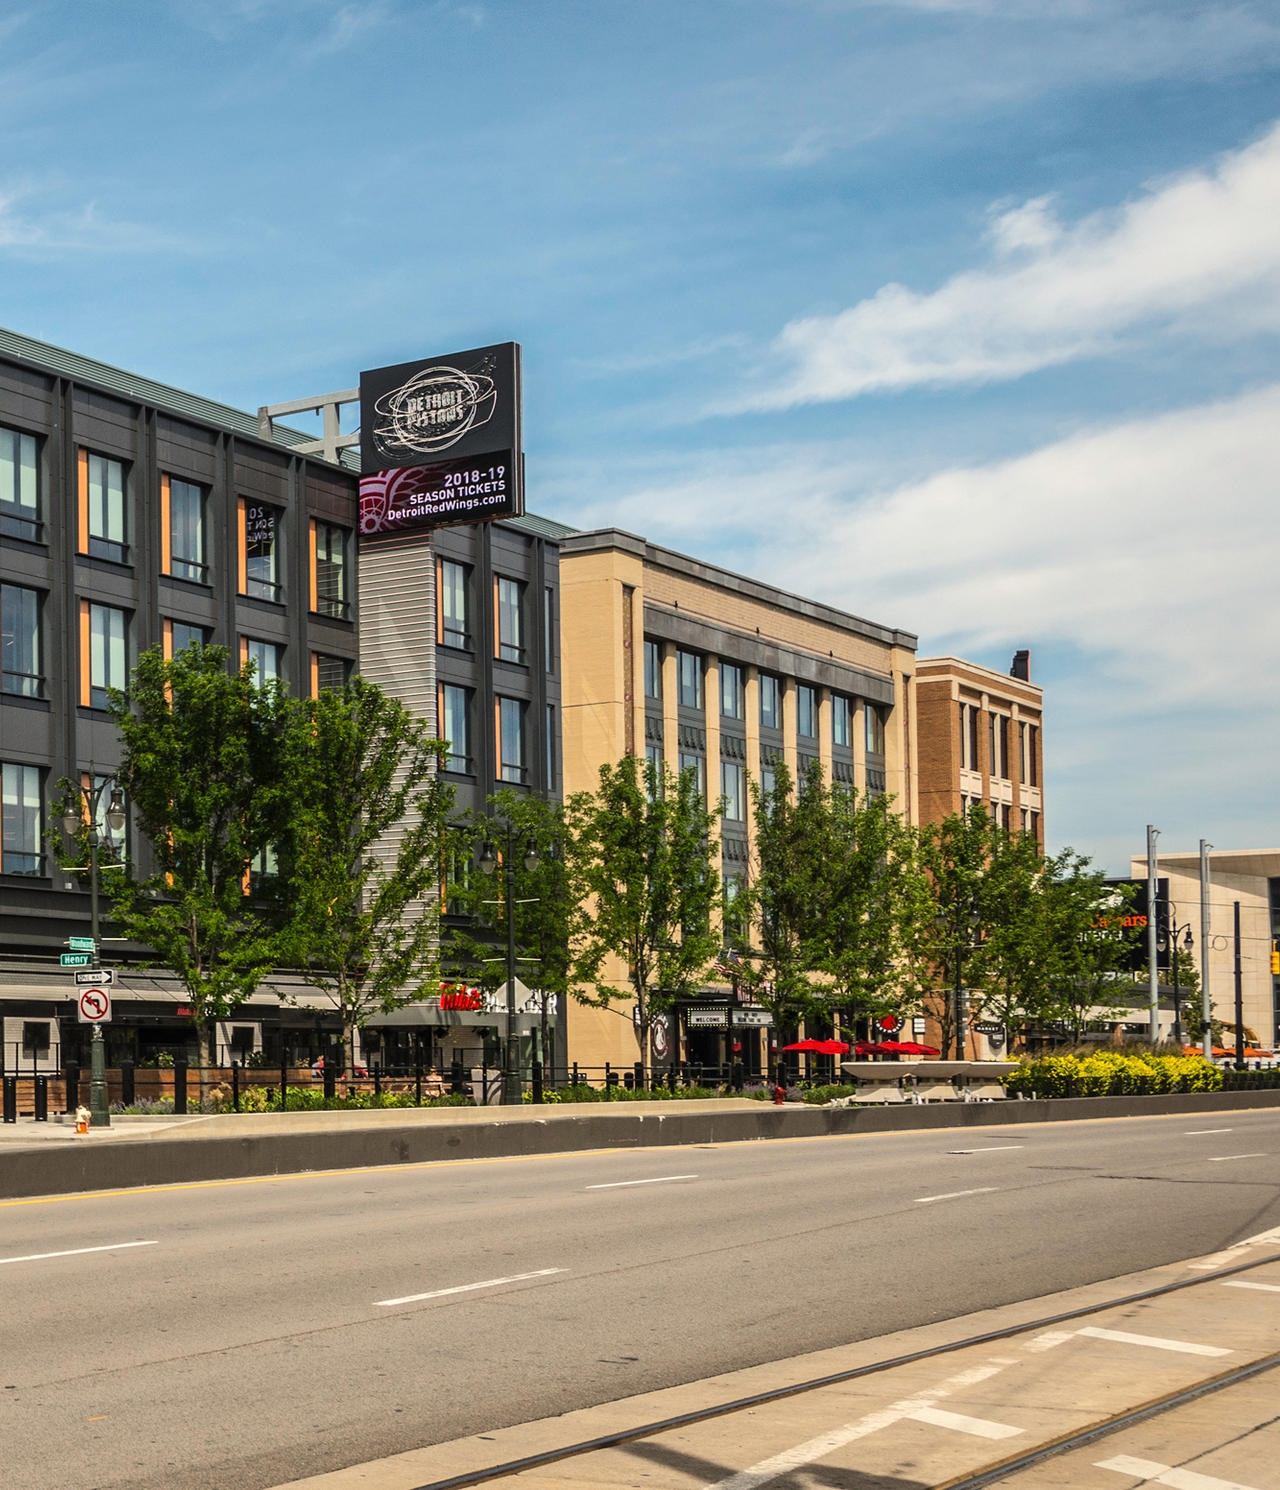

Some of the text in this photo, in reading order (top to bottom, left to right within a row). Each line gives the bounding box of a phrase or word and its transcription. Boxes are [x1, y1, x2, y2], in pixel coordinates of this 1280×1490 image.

[406, 389, 465, 413] DETROIT
[406, 404, 466, 429] PISTONS
[444, 465, 506, 488] 2018-19
[409, 480, 506, 505] SEASON TICKETS
[388, 494, 506, 521] DetroitRedWings.com
[64, 955, 89, 965] Henry
